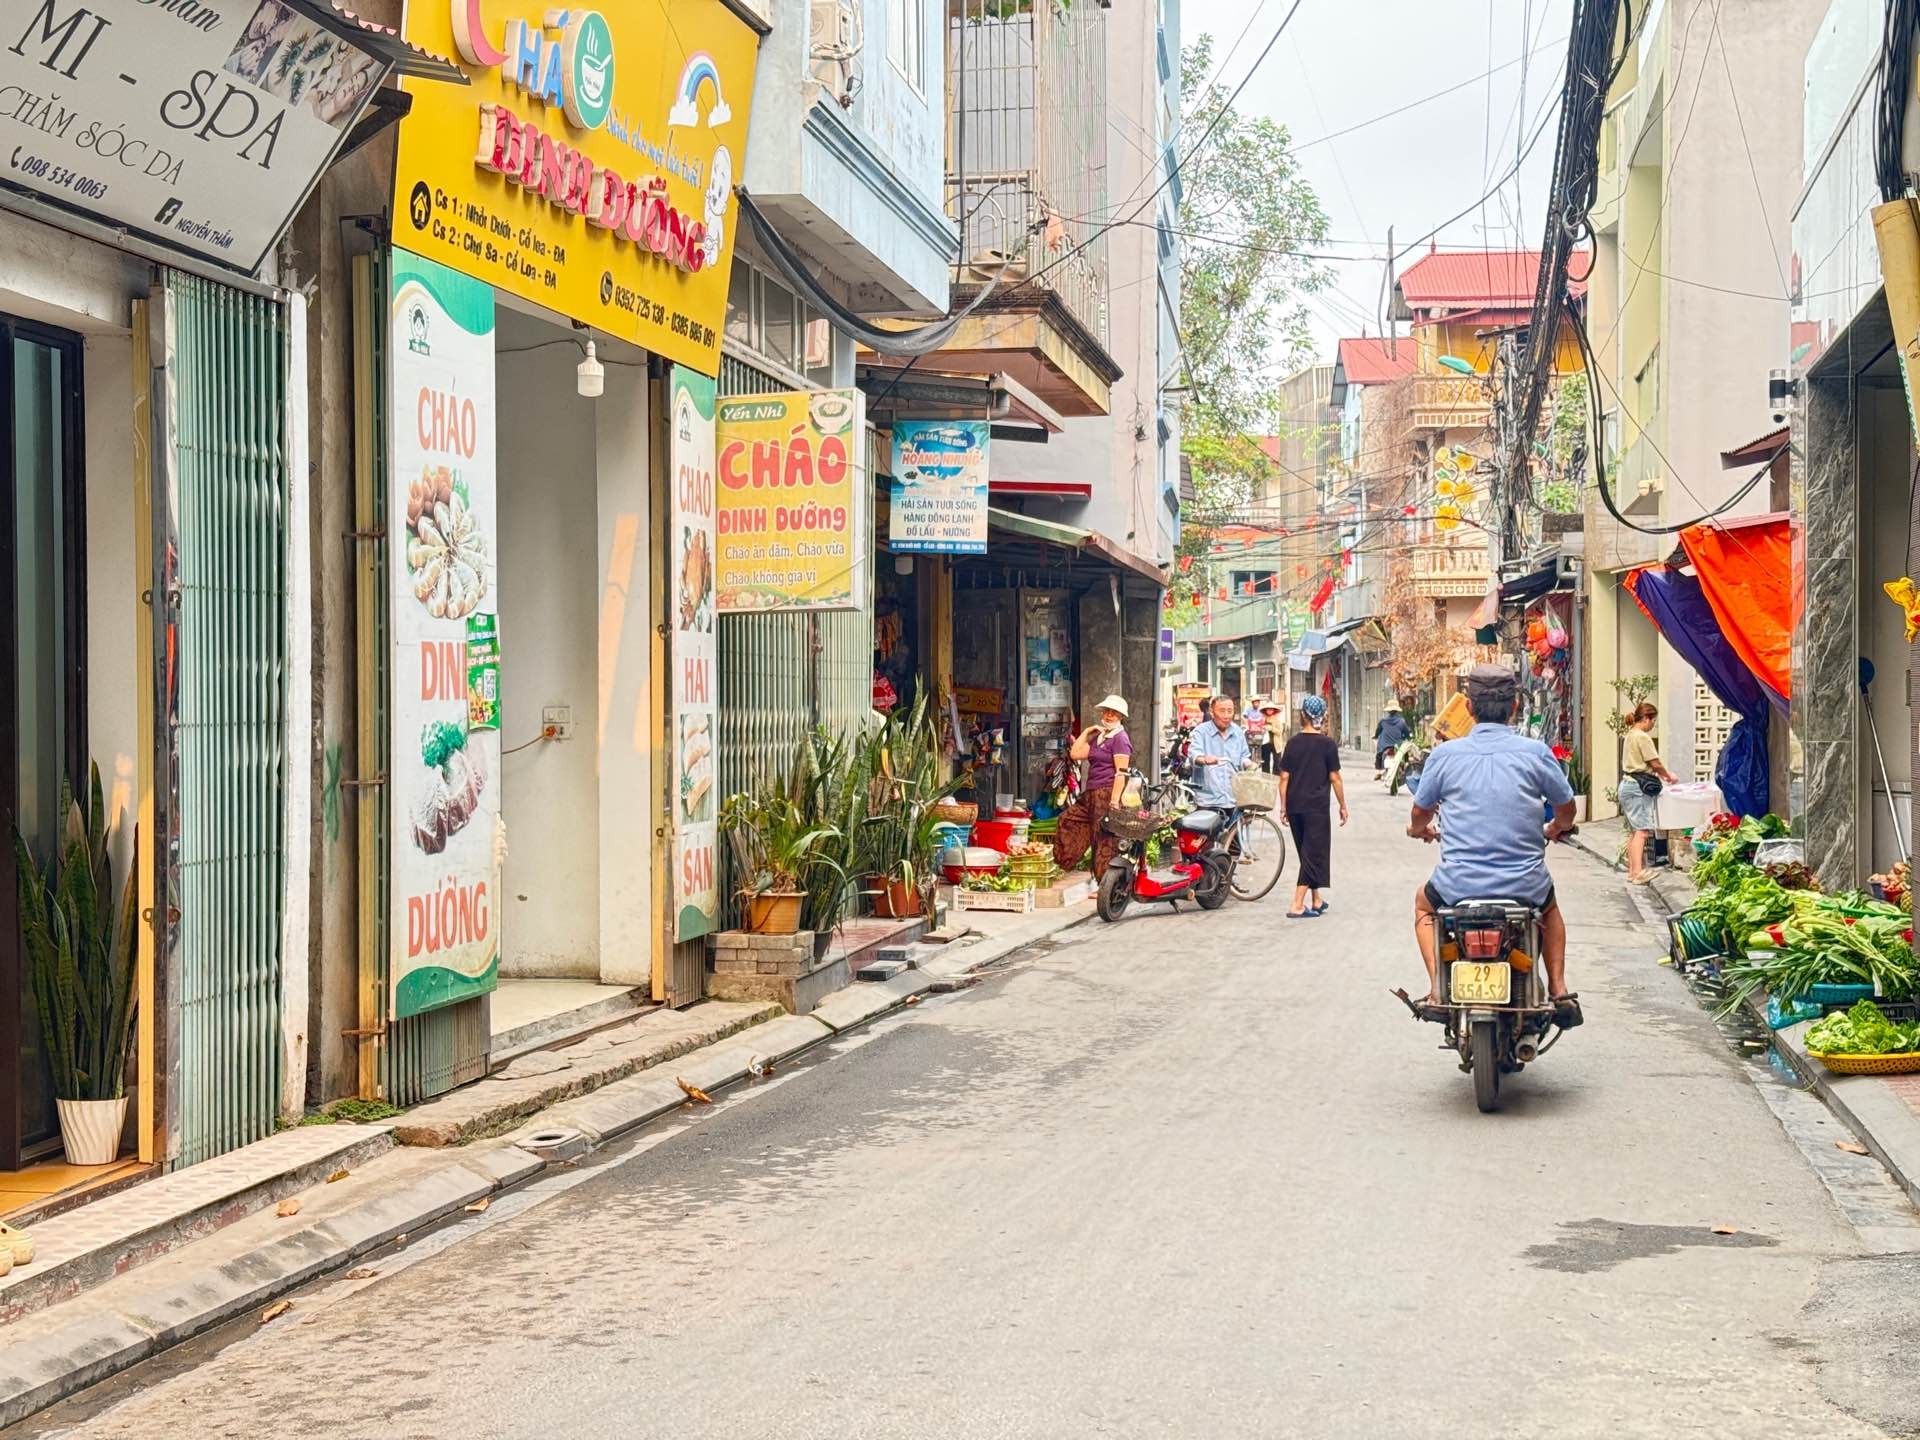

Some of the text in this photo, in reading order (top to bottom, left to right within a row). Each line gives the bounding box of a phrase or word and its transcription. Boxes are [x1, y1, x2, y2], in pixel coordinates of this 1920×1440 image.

[8, 0, 112, 80] MI
[160, 69, 289, 170] SPA
[0, 86, 185, 186] CHĂM SÓC DA
[475, 102, 594, 216] DINH
[21, 155, 108, 200] 098 534 0063
[435, 188, 448, 210] Cs
[432, 218, 446, 241] Cs
[463, 232, 483, 261] Chợ
[485, 242, 498, 263] Sa
[520, 257, 536, 280] Loa
[416, 375, 477, 460] CHÁO
[723, 404, 783, 421] Yến Nhi
[718, 423, 848, 490] CHÁO
[718, 508, 767, 535] DINH
[724, 569, 750, 586] Cháo
[787, 570, 803, 586] gia
[725, 545, 750, 561] Cháo
[796, 542, 822, 557] Cháo
[420, 640, 469, 701] DIN
[1474, 965, 1491, 982] 29
